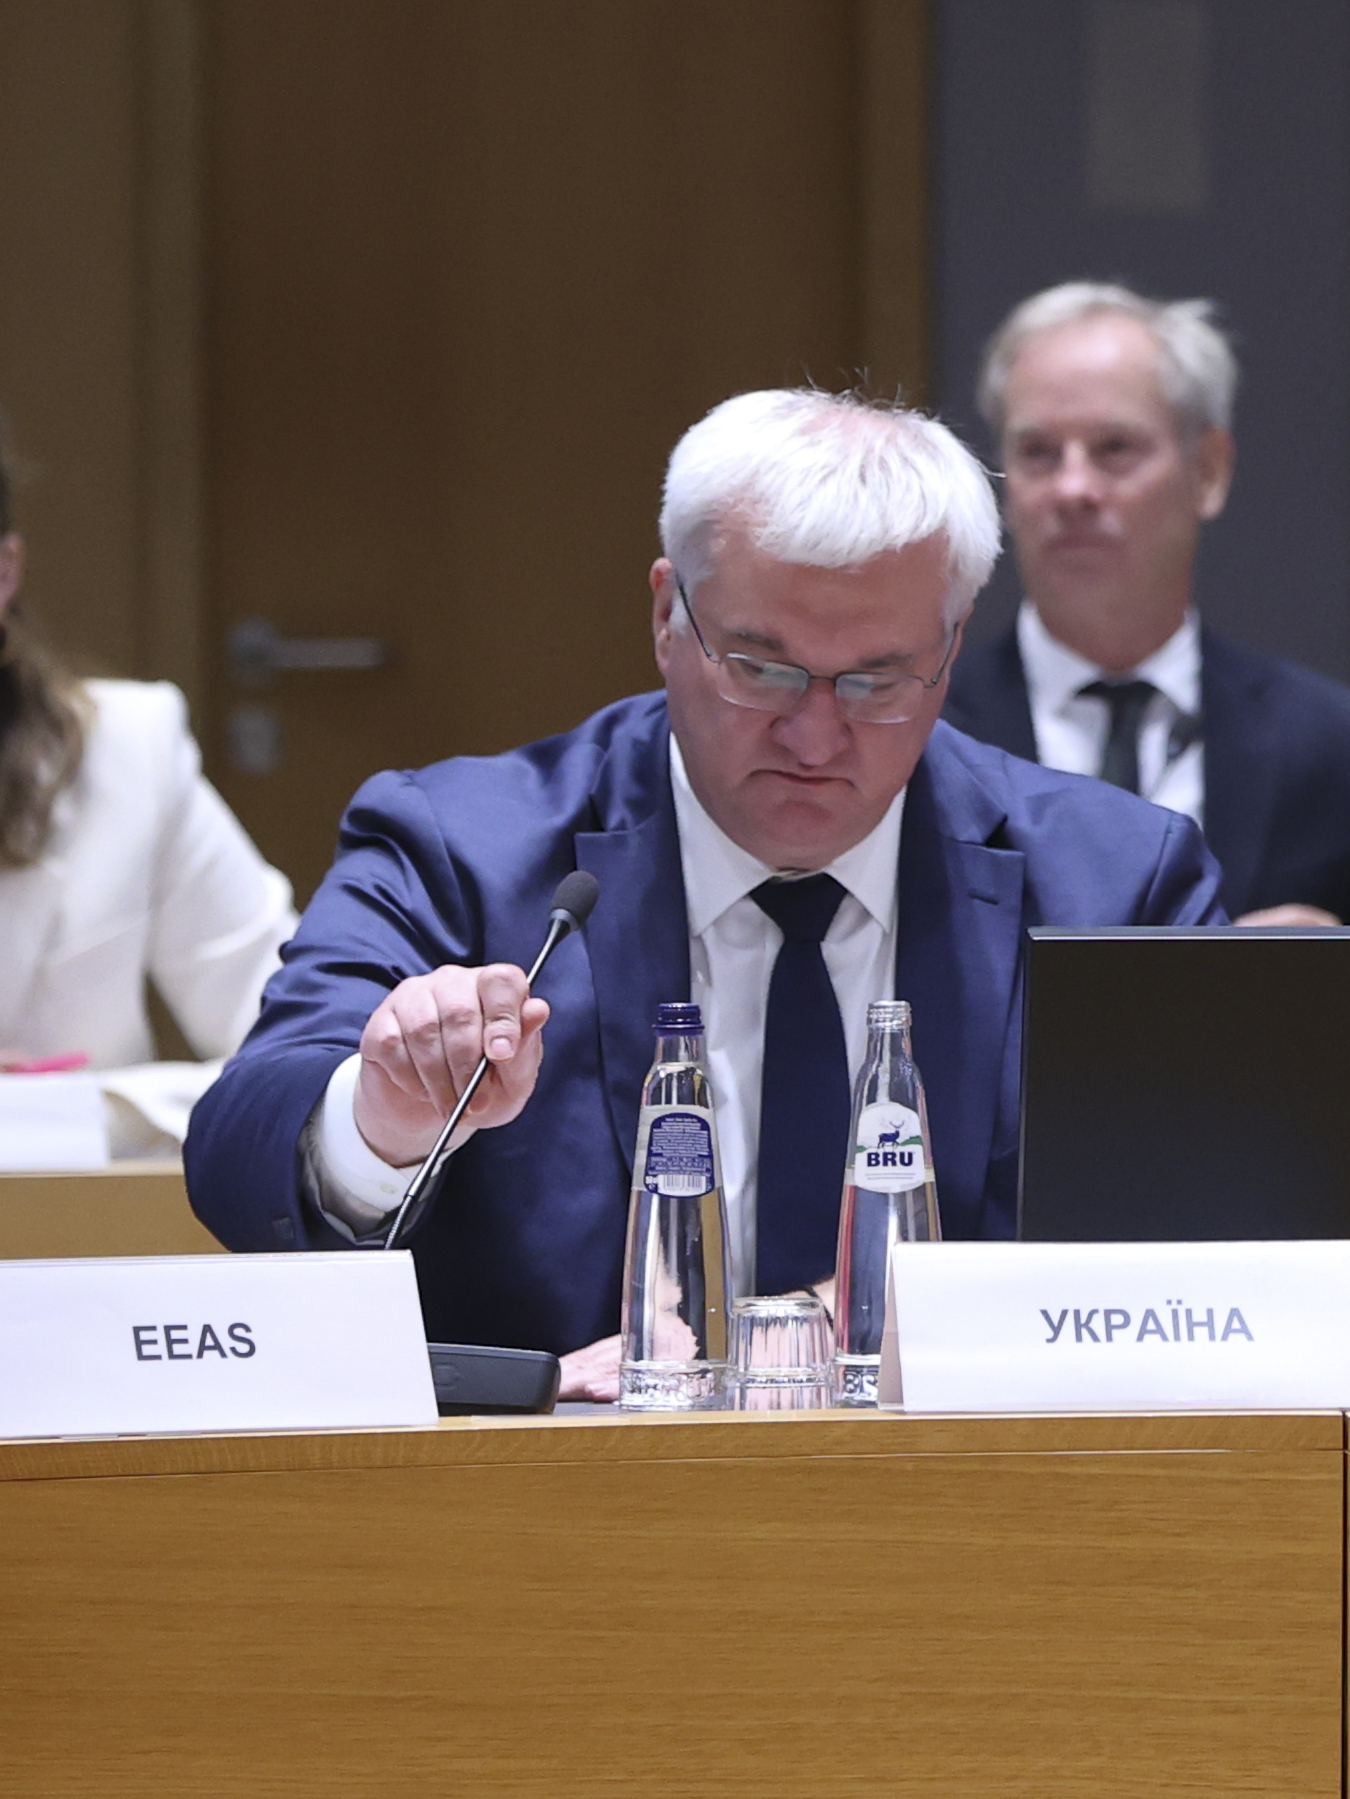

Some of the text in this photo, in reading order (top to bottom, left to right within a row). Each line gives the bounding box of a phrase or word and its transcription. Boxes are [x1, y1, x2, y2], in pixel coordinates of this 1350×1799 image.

[867, 1151, 913, 1168] BRU
[1039, 1299, 1255, 1343] УКРАЇНА
[132, 1322, 257, 1361] EEAS
